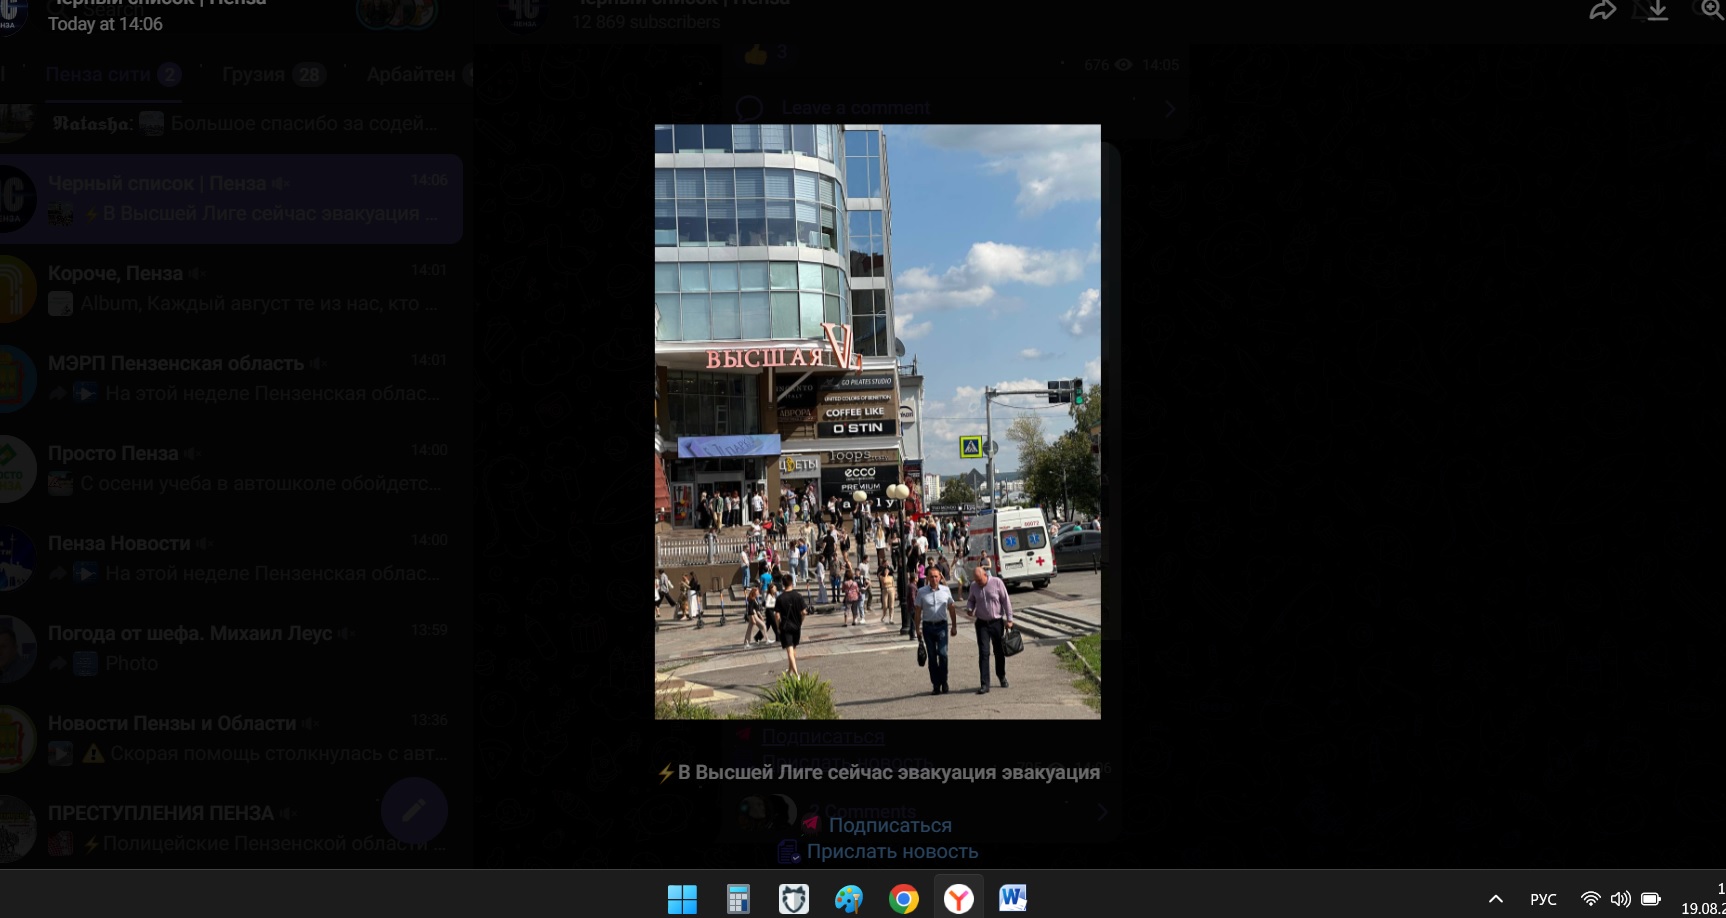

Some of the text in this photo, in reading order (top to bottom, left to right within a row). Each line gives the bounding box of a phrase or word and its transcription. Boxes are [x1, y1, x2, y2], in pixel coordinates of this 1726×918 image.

[48, 16, 163, 35] Today at 14:06
[573, 14, 720, 28] 12 869 subscribers
[777, 44, 787, 59] 3
[1085, 59, 1179, 71] 676 14:05
[47, 66, 174, 82] Пенза сити 2
[223, 66, 319, 86] Грузия 28
[367, 66, 455, 86] Арбайтен
[783, 99, 931, 116] Leave a comment
[171, 115, 256, 131] Большое
[261, 115, 338, 131] спасибо
[343, 119, 364, 131] за
[49, 175, 122, 194] Черный
[128, 179, 194, 190] список
[210, 176, 266, 191] Пенза
[411, 174, 448, 186] 14:06
[104, 203, 419, 225] В Высшей Лиге сейчас эвакуация
[49, 265, 183, 284] Короче, Пенза
[411, 264, 446, 276] 14:01
[81, 294, 420, 314] Album, Каждый август те из нас, кто
[49, 355, 304, 371] МЭРП Пензенская область
[411, 354, 446, 366] 14:01
[706, 348, 824, 369] ВЫСШАЯ
[850, 378, 871, 386] PILATES
[871, 377, 892, 385] STUDIO
[106, 386, 131, 401] На
[136, 385, 178, 401] этой
[184, 389, 250, 405] неделе
[256, 386, 366, 401] Пензенская
[825, 407, 885, 418] COFFEE LIKE
[49, 445, 179, 464] Просто Пенза
[411, 444, 448, 456] 14:00
[844, 467, 876, 478] ecco
[81, 475, 94, 491] С
[99, 479, 154, 491] осени
[159, 475, 212, 494] учеба
[218, 479, 228, 491] в
[234, 479, 337, 491] автошколе
[49, 535, 191, 551] Пенза Новости
[411, 534, 448, 546] 14:00
[106, 566, 131, 581] На
[136, 565, 178, 581] этой
[184, 569, 250, 584] неделе
[256, 566, 366, 581] Пензенская
[49, 625, 333, 645] Погода от шефа. Михаил Леус
[411, 624, 448, 636] 13:59
[106, 655, 159, 672] Photo
[49, 715, 297, 731] Новости Пензы и Области
[411, 714, 448, 726] 13:36
[762, 729, 885, 747] Подписаться
[111, 745, 179, 764] Скорая
[184, 749, 261, 764] помощь
[266, 749, 383, 765] столкнулась
[388, 749, 399, 761] с
[678, 763, 1101, 784] В Высшей Лиге сейчас эвакуация эвакуация
[49, 805, 205, 822] ПРЕСТУПЛЕНИЯ
[210, 805, 275, 821] ПЕНЗА
[825, 803, 917, 819] Comments
[829, 817, 952, 835] Подписаться
[104, 834, 429, 853] Полицейские Пензенской области
[807, 844, 979, 862] Прислать новость
[1530, 893, 1557, 906] РУС
